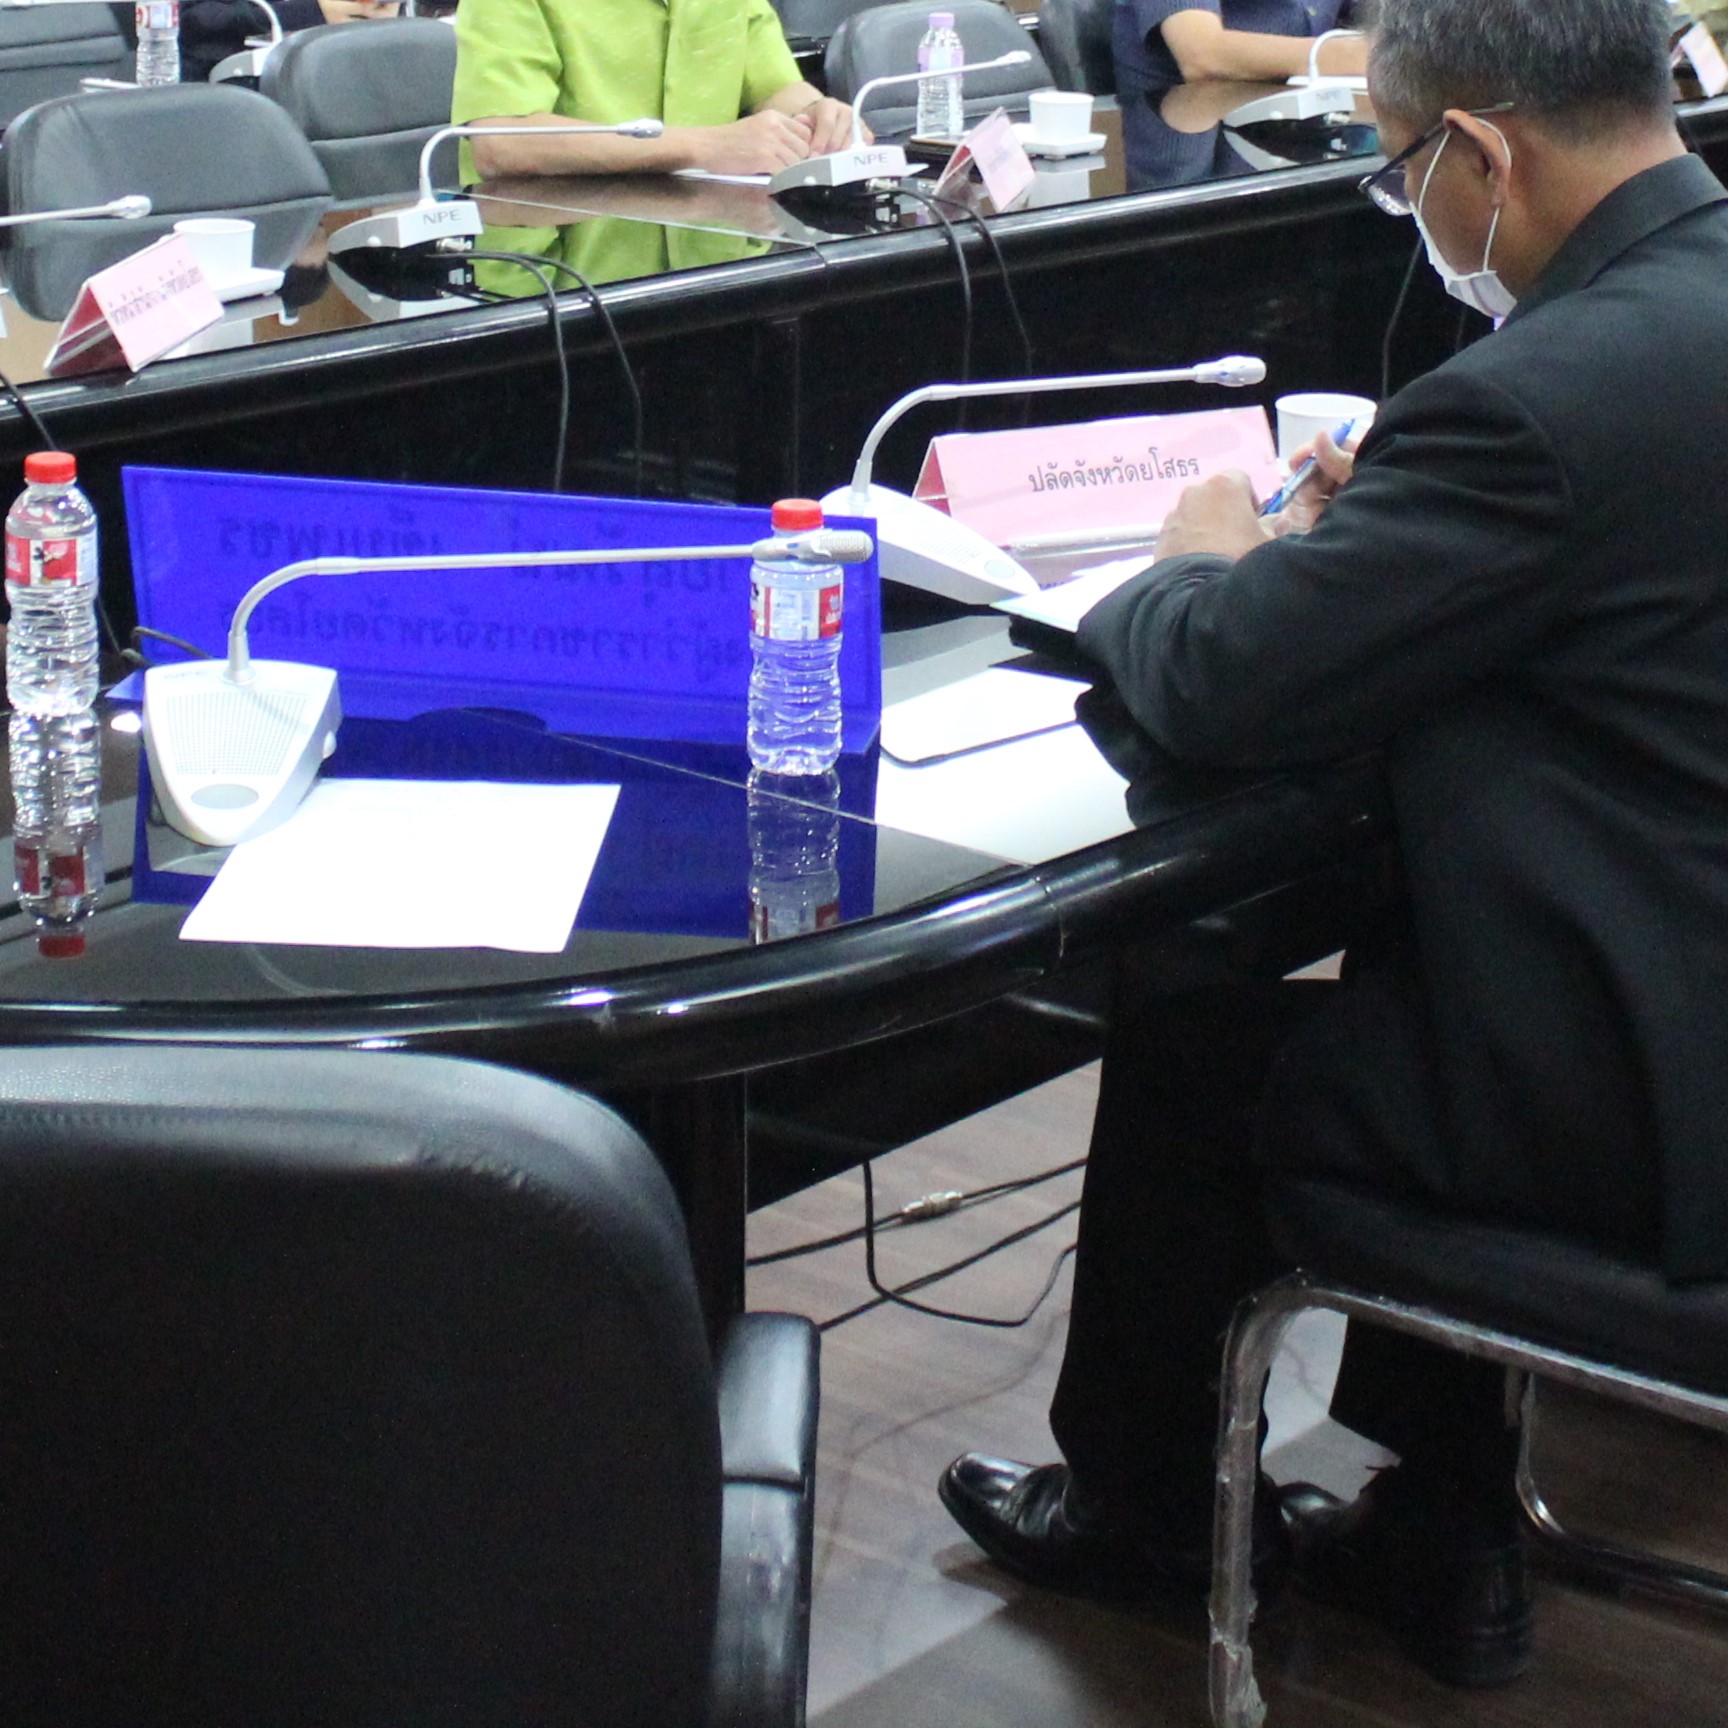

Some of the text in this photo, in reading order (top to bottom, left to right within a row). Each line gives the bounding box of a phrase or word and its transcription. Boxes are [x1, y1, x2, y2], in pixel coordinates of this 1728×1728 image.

[853, 152, 889, 167] NPE
[422, 207, 462, 225] NPE
[1027, 446, 1201, 493] ปลัดจังหวัดยโสธร
